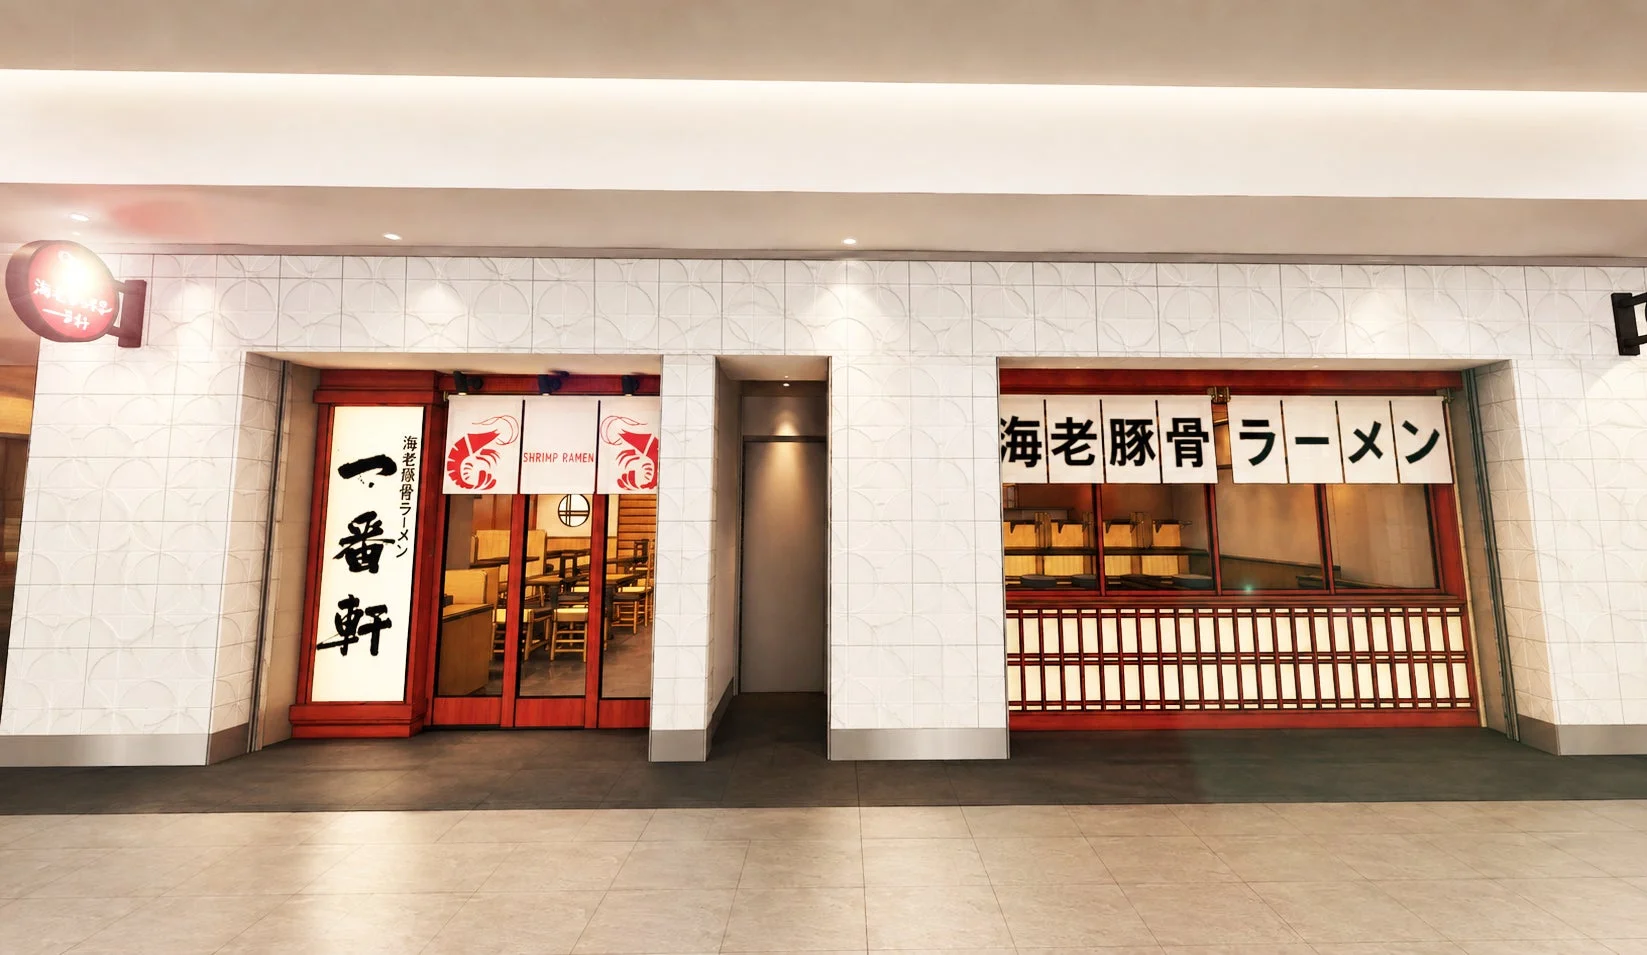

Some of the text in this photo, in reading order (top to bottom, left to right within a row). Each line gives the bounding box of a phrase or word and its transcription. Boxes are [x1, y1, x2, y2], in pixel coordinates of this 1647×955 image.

[523, 452, 594, 463] SHRIMP RAMEN
[316, 453, 397, 657] 一番軒
